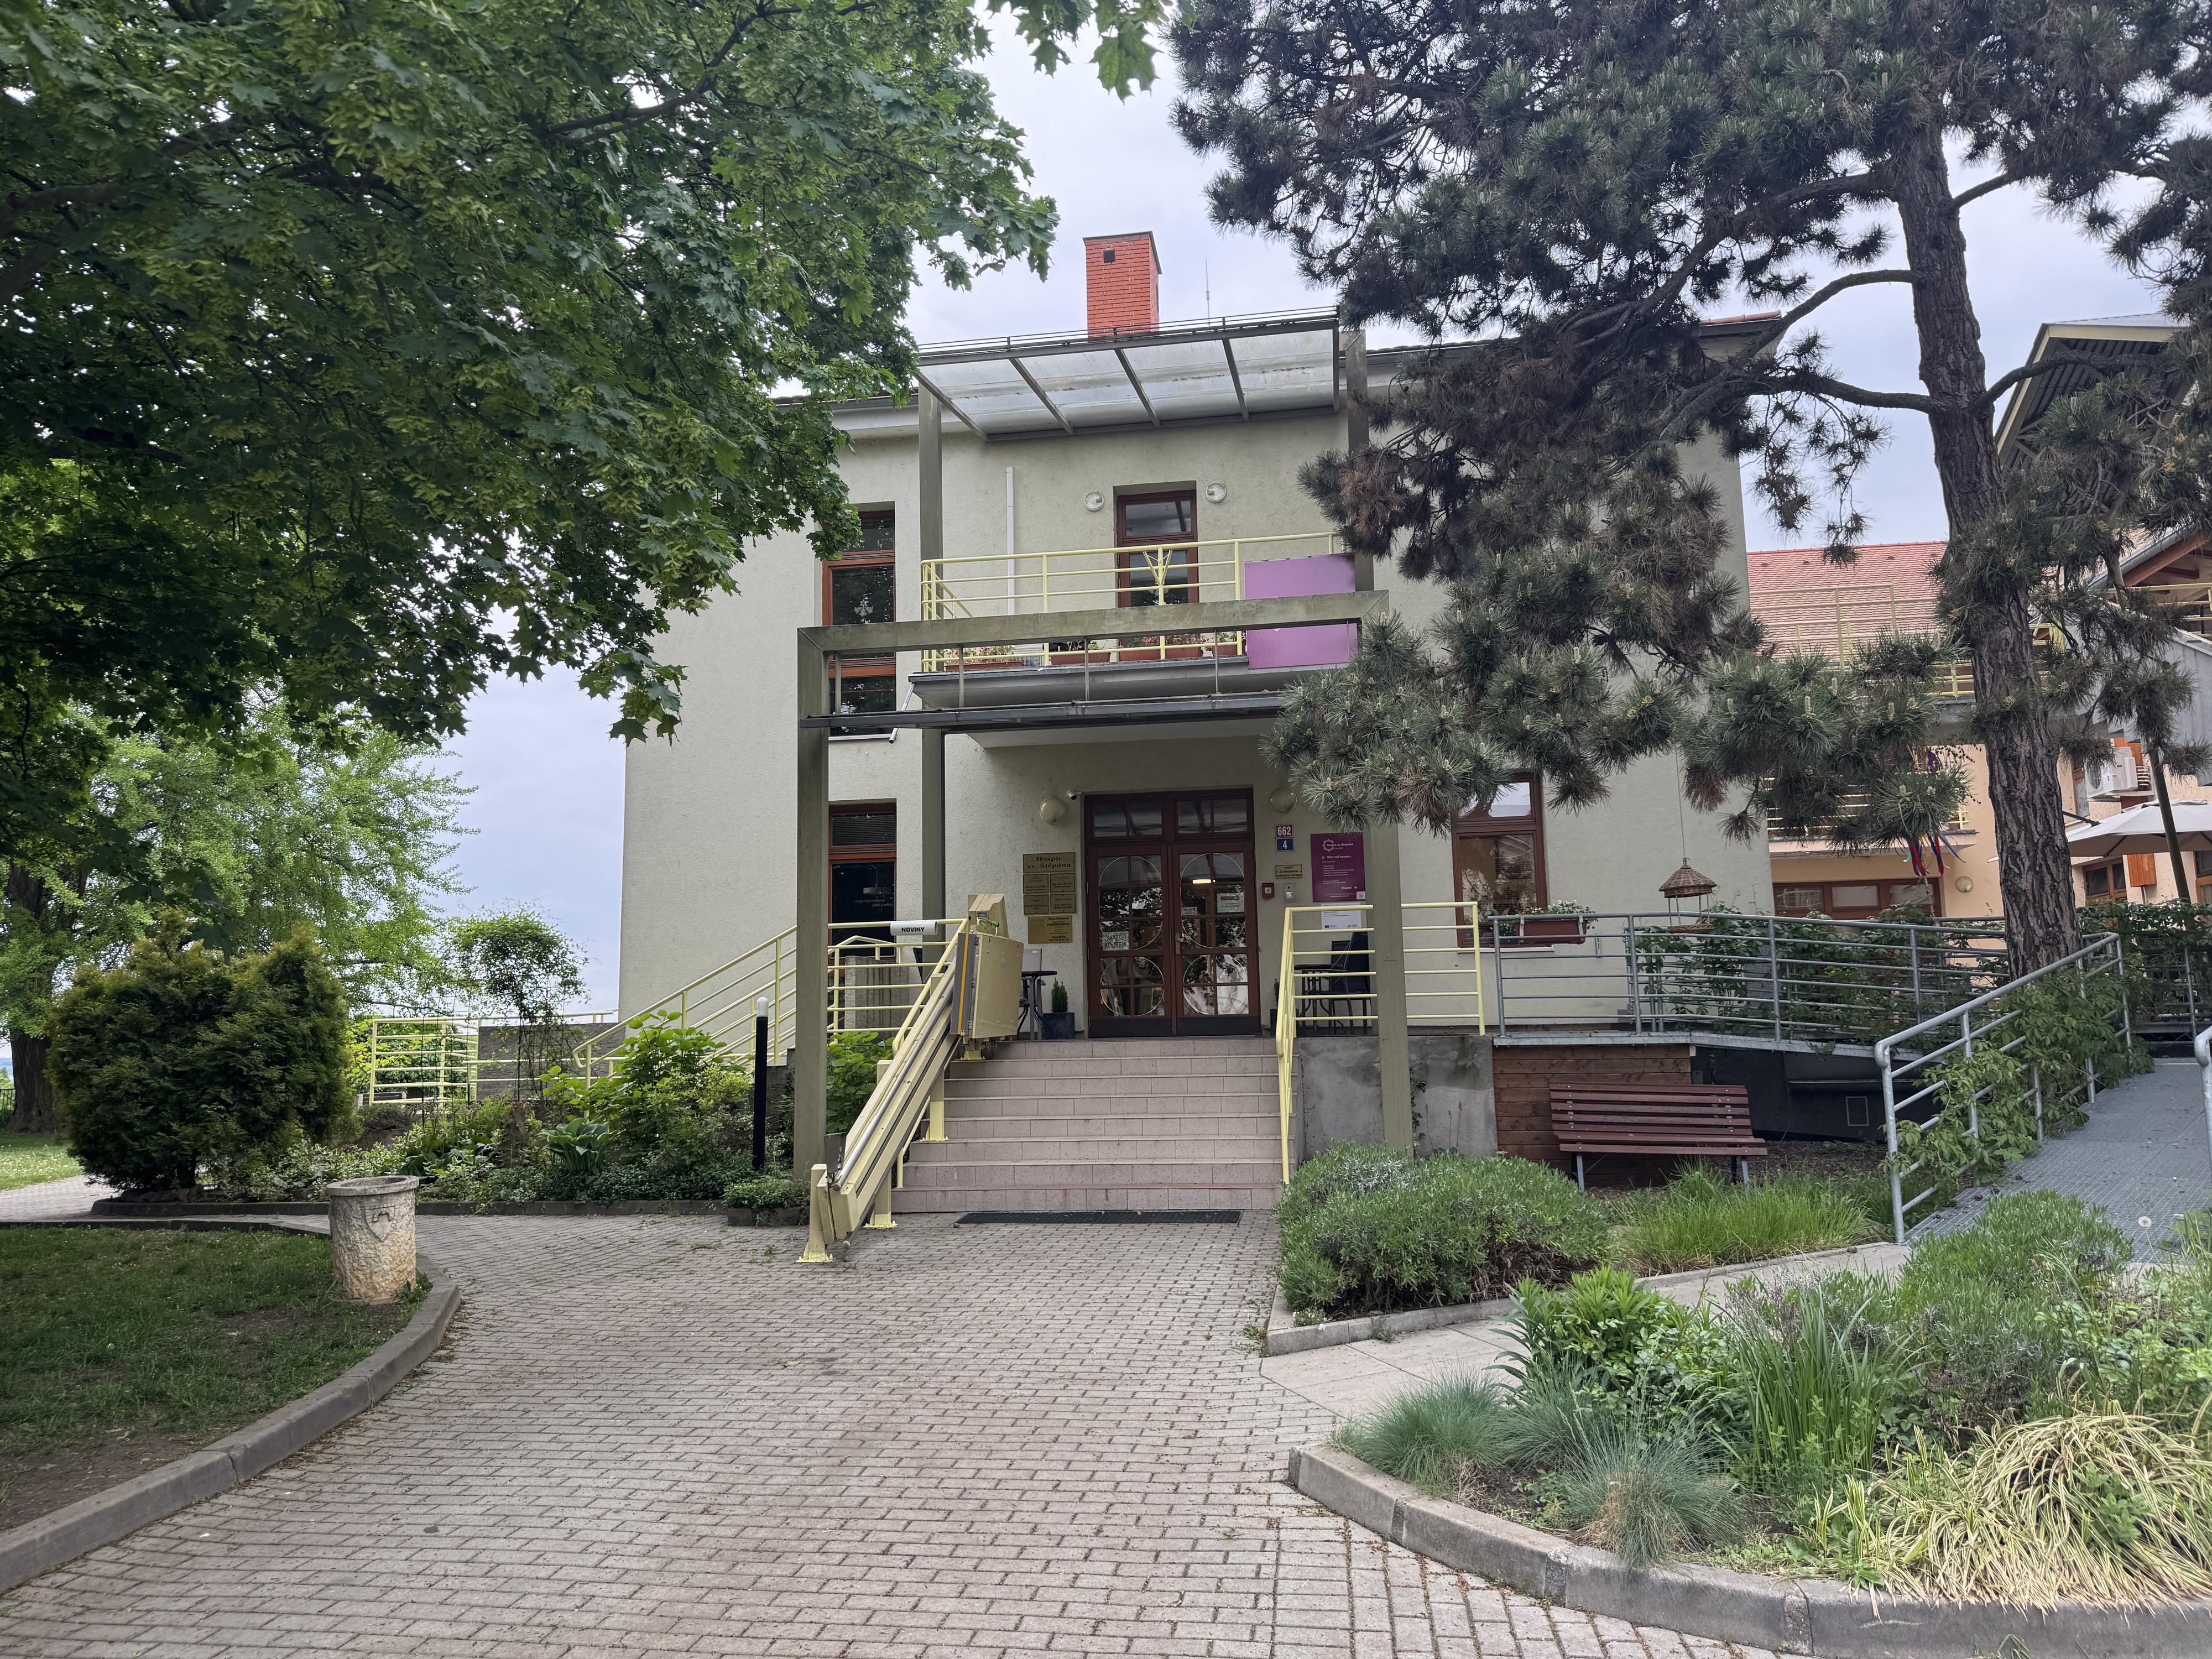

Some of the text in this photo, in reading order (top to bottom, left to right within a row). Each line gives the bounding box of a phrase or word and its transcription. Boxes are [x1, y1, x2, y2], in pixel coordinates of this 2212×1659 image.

[1277, 826, 1291, 836] 662
[1282, 840, 1287, 849] 4
[1103, 933, 1119, 941] ÁKAZ
